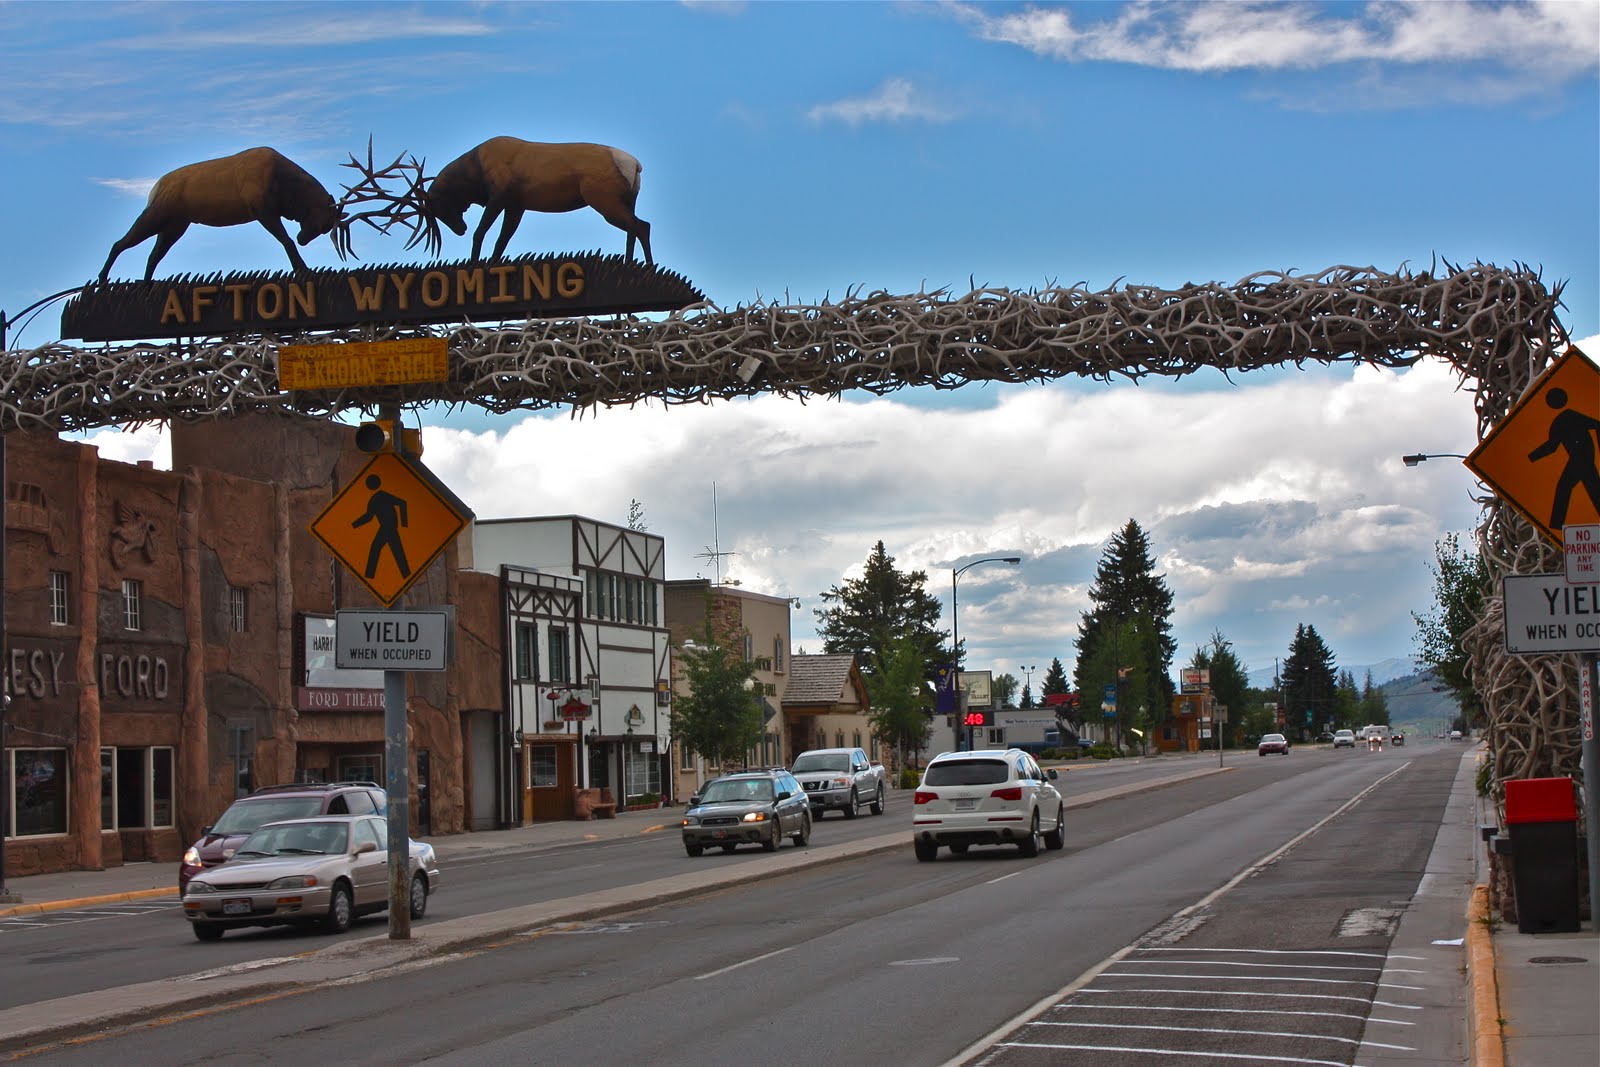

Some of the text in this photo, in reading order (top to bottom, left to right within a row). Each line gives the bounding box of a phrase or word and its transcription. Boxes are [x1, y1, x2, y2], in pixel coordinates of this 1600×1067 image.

[160, 262, 584, 324] AFTON WYOMING
[368, 342, 430, 355] LARGEST
[293, 353, 436, 387] ELKHORN ARCH
[1576, 530, 1591, 541] NO
[1577, 555, 1592, 563] ANY
[1577, 564, 1594, 572] TIME
[1543, 586, 1600, 615] YIEL
[363, 622, 419, 643] YIELD
[1526, 624, 1567, 640] WHEN
[313, 636, 334, 651] HARRY
[350, 649, 431, 660] WHEN OCCUPIED
[12, 649, 168, 698] ESY FORD
[309, 692, 385, 708] FORD THEATR
[1582, 670, 1592, 739] PARKING
